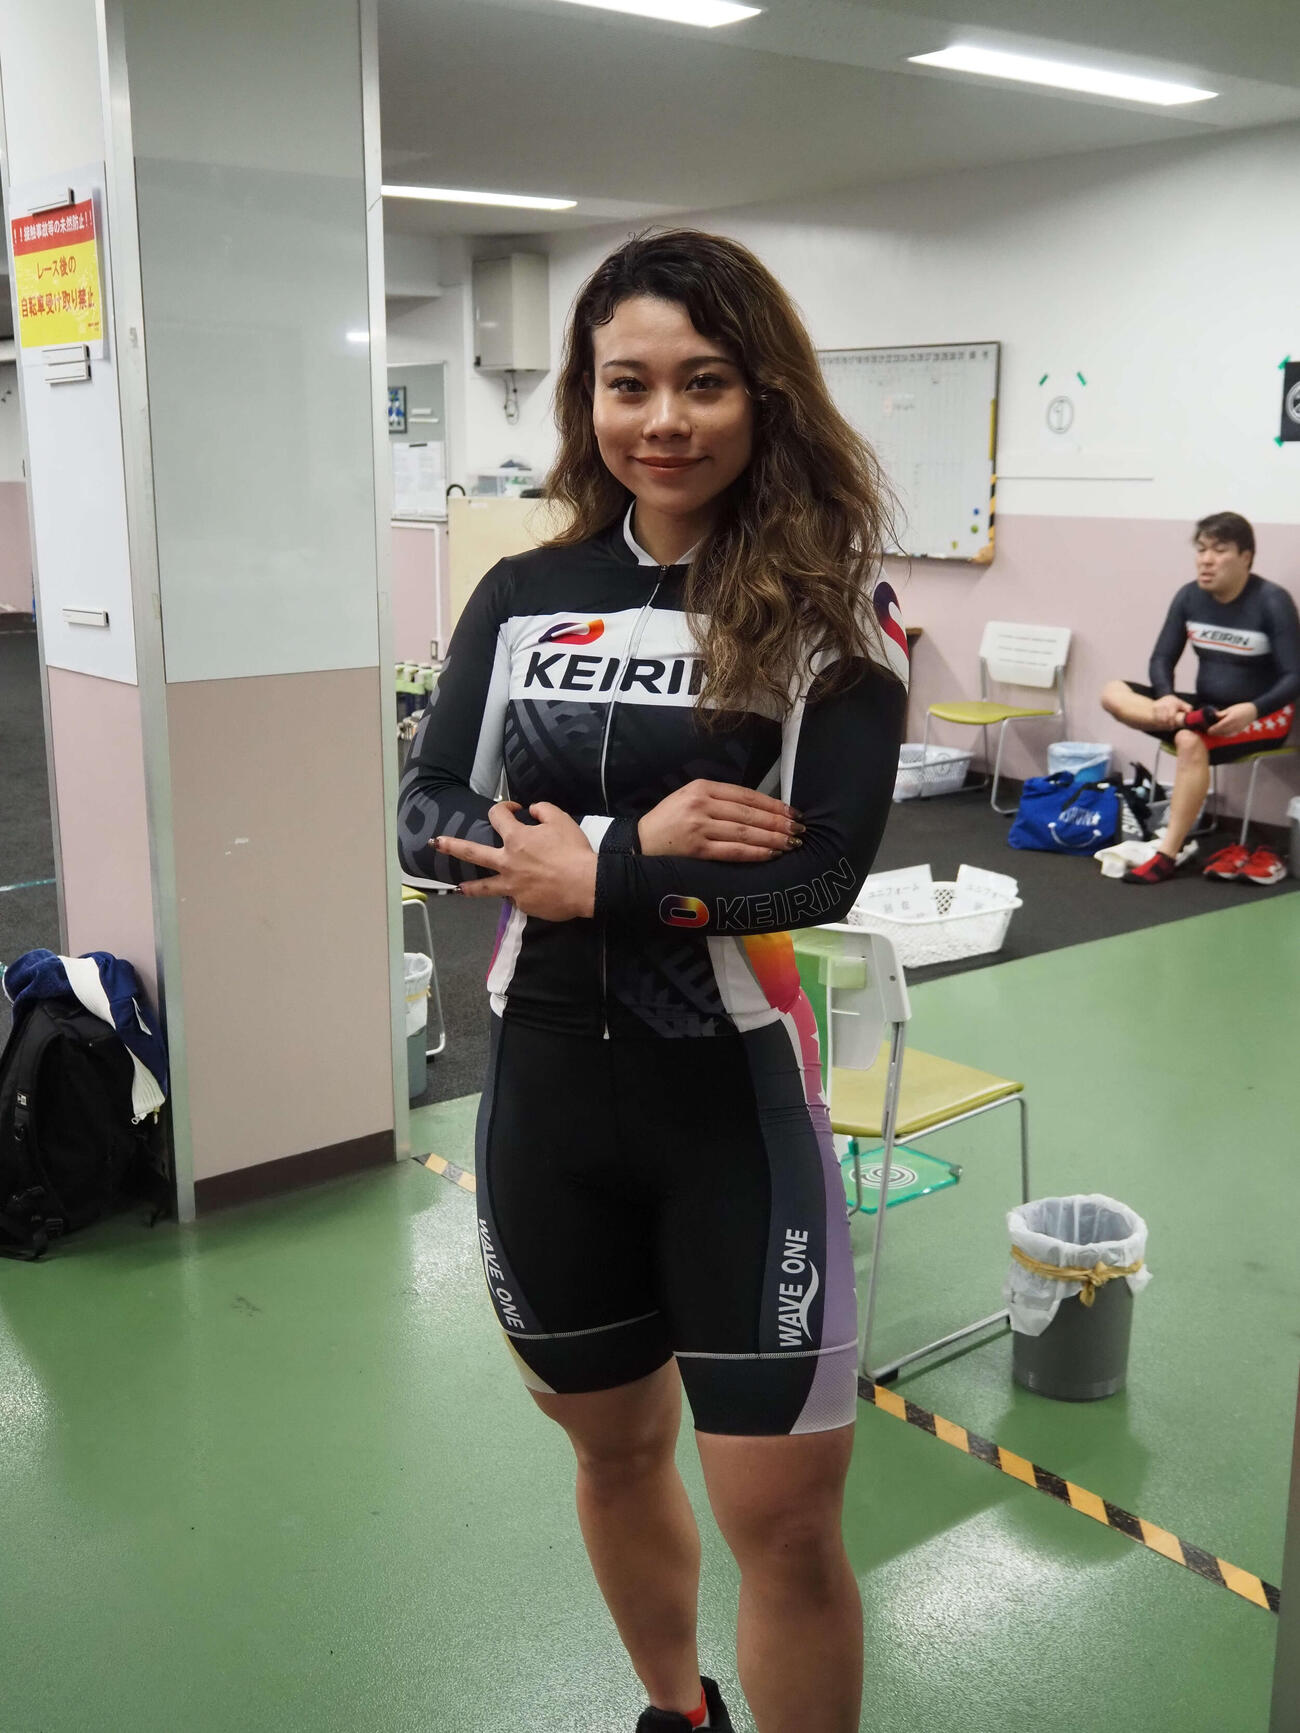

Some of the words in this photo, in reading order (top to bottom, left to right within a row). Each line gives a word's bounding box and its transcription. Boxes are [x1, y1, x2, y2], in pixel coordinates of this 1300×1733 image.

[37, 255, 77, 280] レース後の
[21, 286, 95, 318] 自転車受け取り禁止
[1200, 629, 1250, 646] KEIRIN
[716, 857, 858, 930] KEIRIN
[479, 1218, 505, 1281] WAVE
[495, 1287, 526, 1329] ONE
[781, 1228, 809, 1274] ONE
[778, 1283, 803, 1347] WAVE
